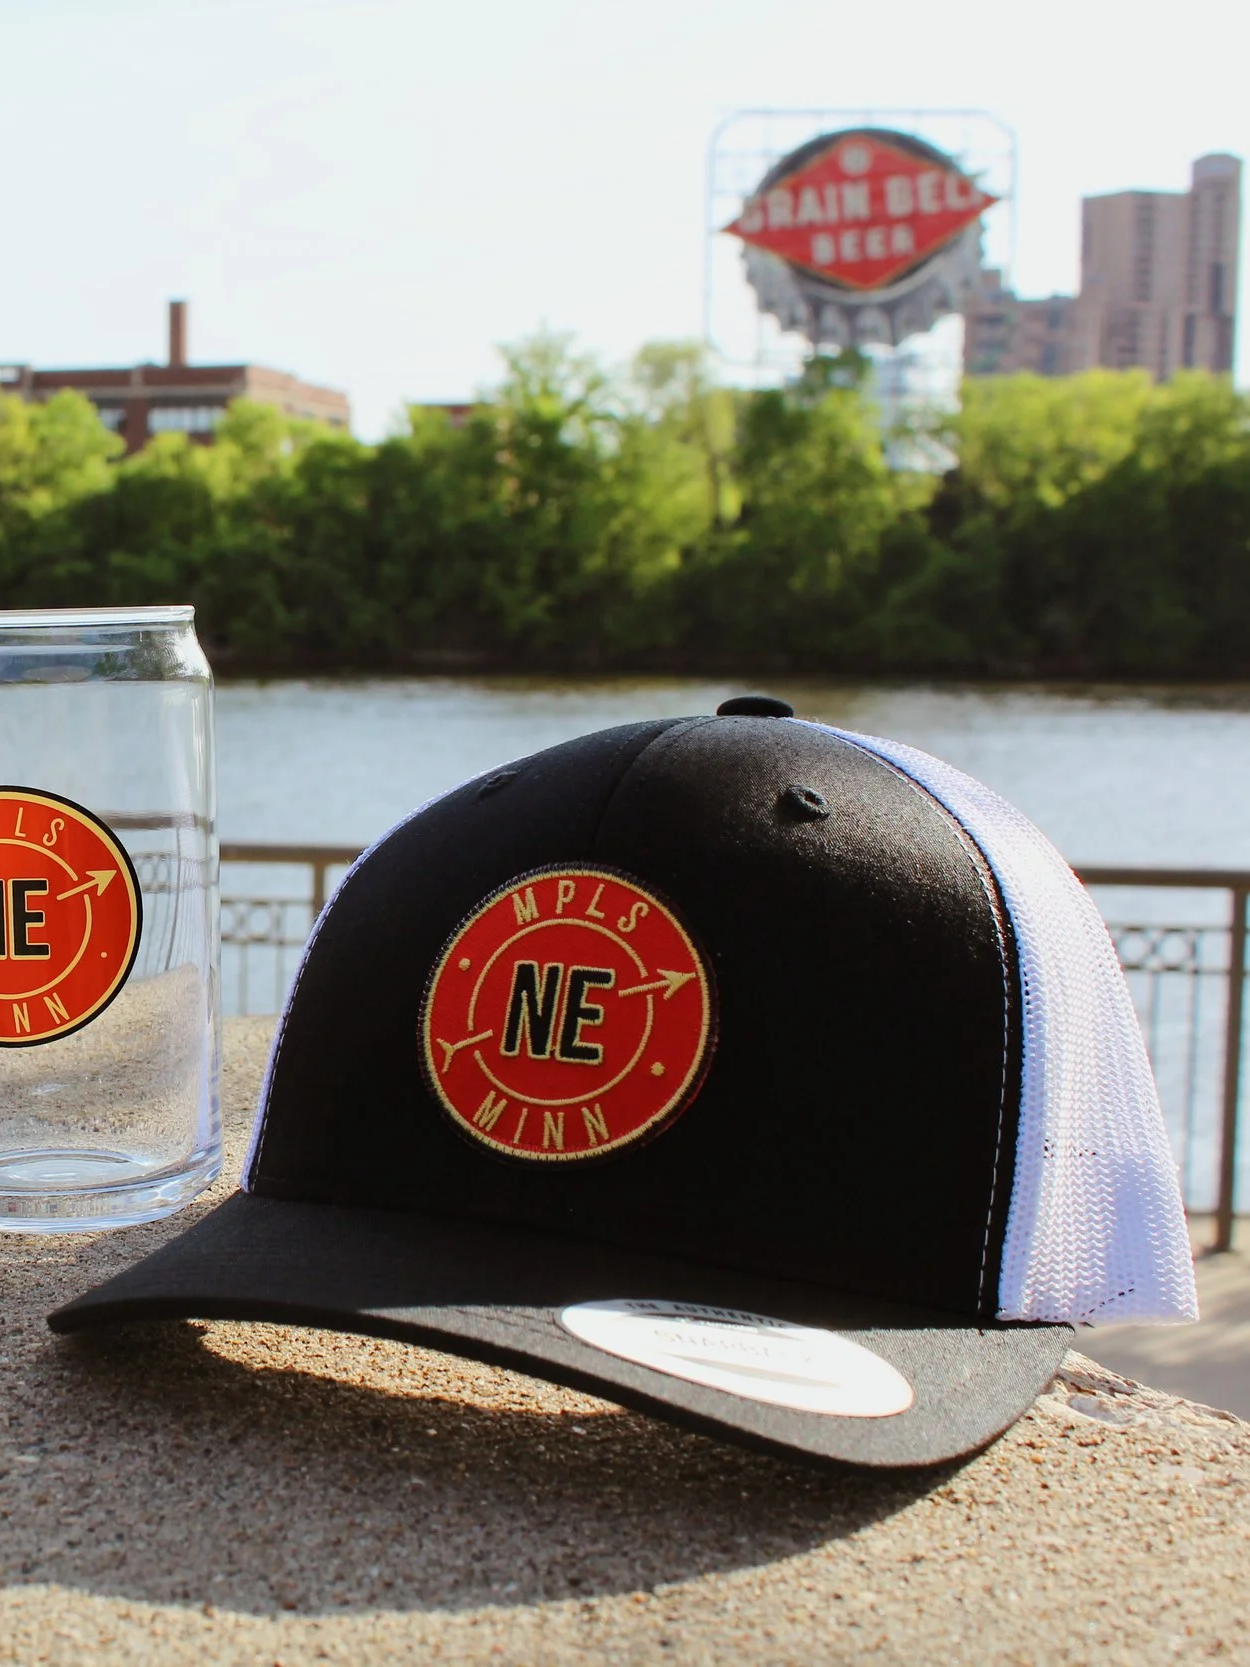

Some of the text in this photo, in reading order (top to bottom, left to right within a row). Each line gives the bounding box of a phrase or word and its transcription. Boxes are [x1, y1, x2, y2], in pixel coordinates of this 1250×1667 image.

[811, 224, 914, 265] BEER
[511, 879, 650, 933] MPLS
[500, 960, 616, 1065] NE
[472, 1089, 610, 1151] MINN
